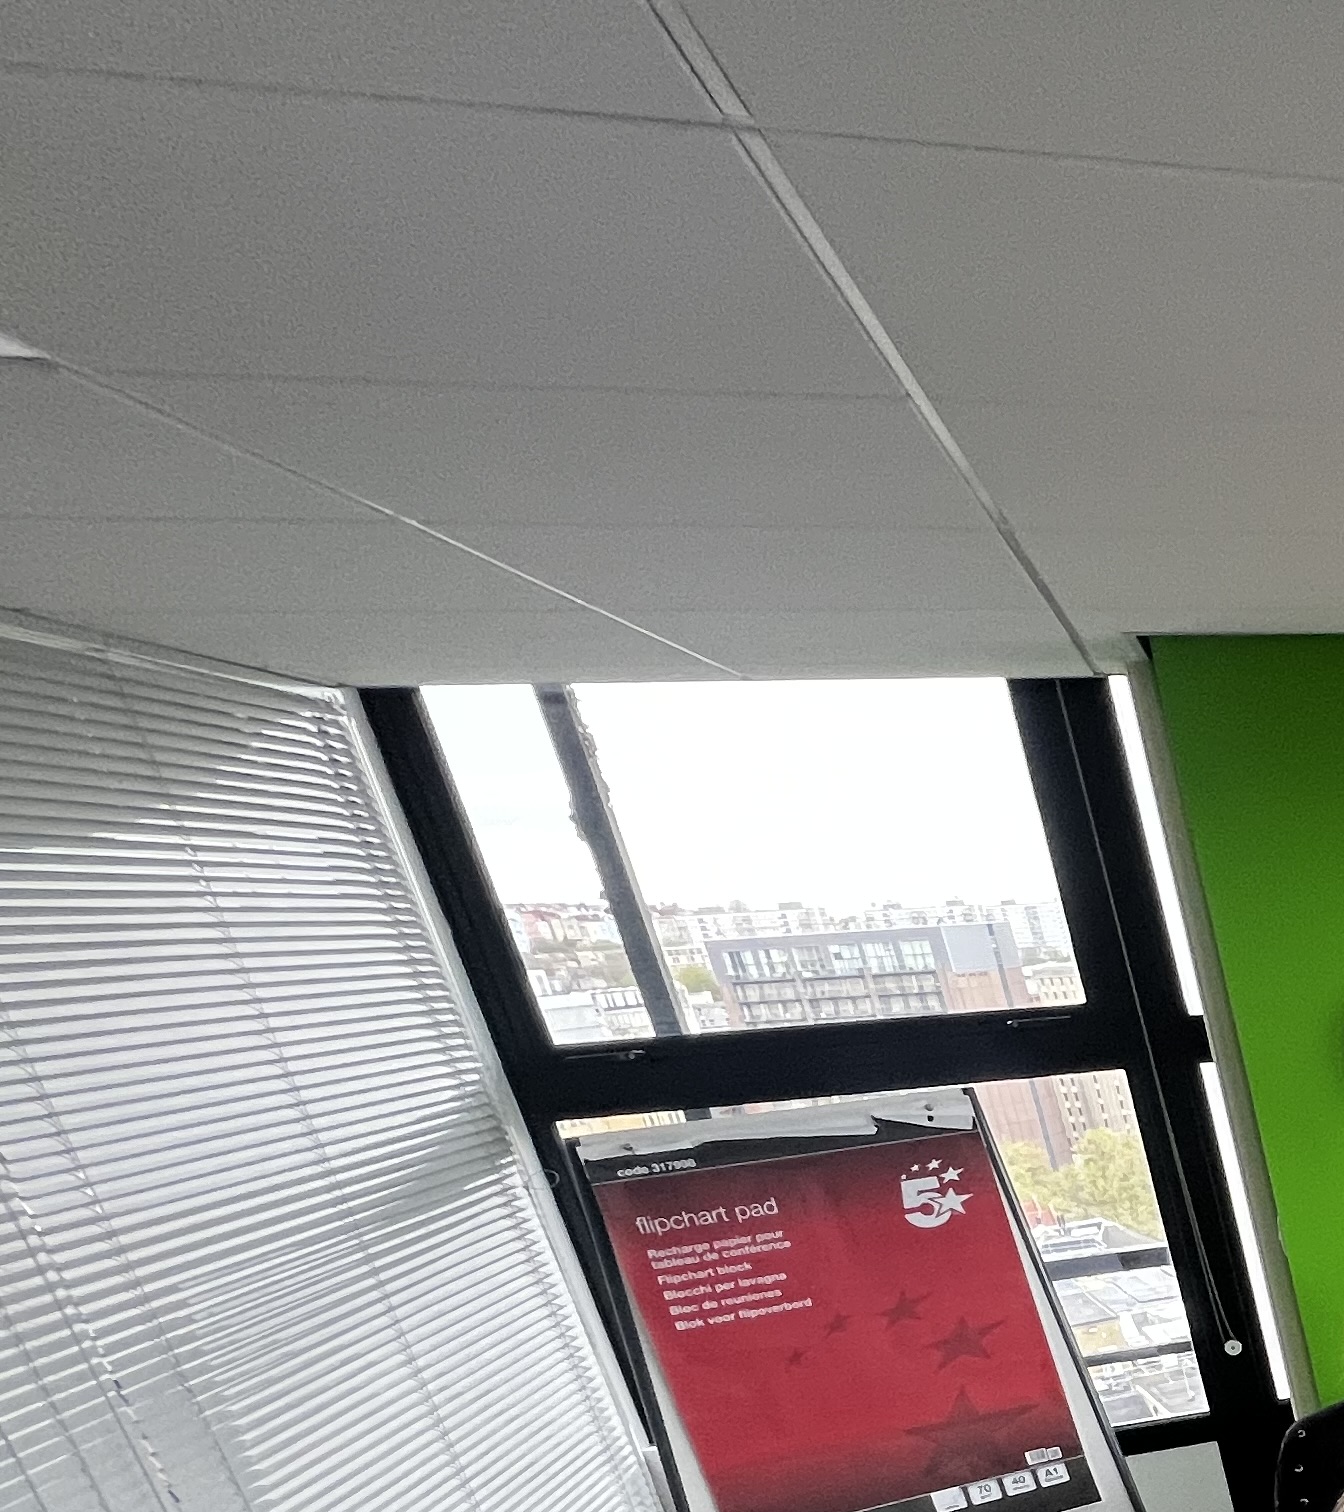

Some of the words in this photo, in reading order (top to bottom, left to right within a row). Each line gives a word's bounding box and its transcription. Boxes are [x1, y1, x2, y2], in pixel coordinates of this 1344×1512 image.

[900, 1175, 952, 1229] 5
[635, 1205, 730, 1236] flipchart
[734, 1197, 780, 1224] pad
[647, 1242, 711, 1259] Recharge
[755, 1230, 784, 1243] pour
[702, 1251, 720, 1262] de
[657, 1267, 715, 1286] Flipchart
[716, 1261, 753, 1275] block
[663, 1284, 713, 1300] Blocchi
[714, 1280, 736, 1294] per
[669, 1303, 700, 1316] Bloc
[701, 1300, 719, 1311] de
[674, 1318, 705, 1331] Blok
[707, 1312, 736, 1325] voor
[1011, 1475, 1026, 1485] 40
[1045, 1467, 1059, 1477] A1
